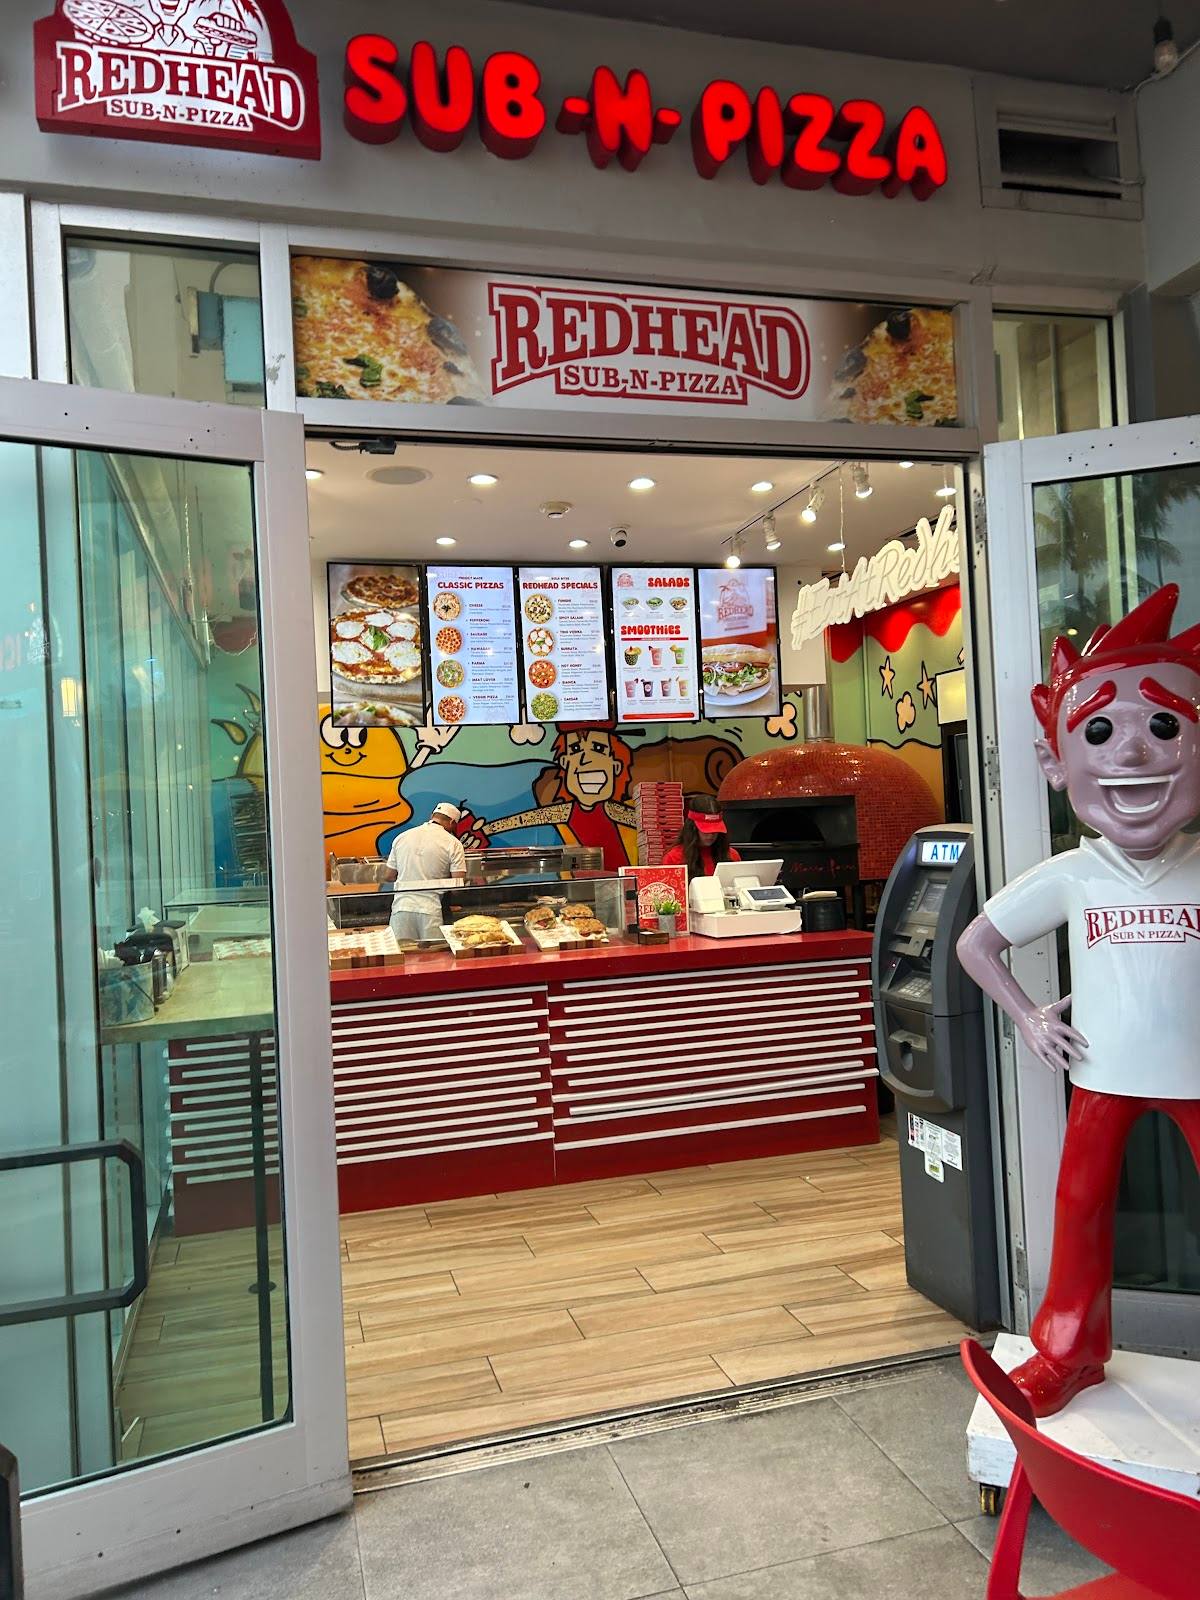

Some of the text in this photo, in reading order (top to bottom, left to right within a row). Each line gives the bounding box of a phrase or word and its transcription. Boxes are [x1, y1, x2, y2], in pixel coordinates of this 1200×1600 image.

[60, 47, 301, 127] REDHEAD
[111, 99, 251, 129] SUB-N-PIZZA
[498, 292, 802, 393] REDHEAD
[563, 365, 740, 396] SUB-N-PIZZA
[437, 581, 504, 590] CLASSIC PIZZAS
[522, 582, 598, 590] REDHEAD SPECIALS
[647, 577, 690, 588] SALADS
[930, 844, 960, 861] ATM
[1112, 930, 1182, 941] SUB N PIZZA
